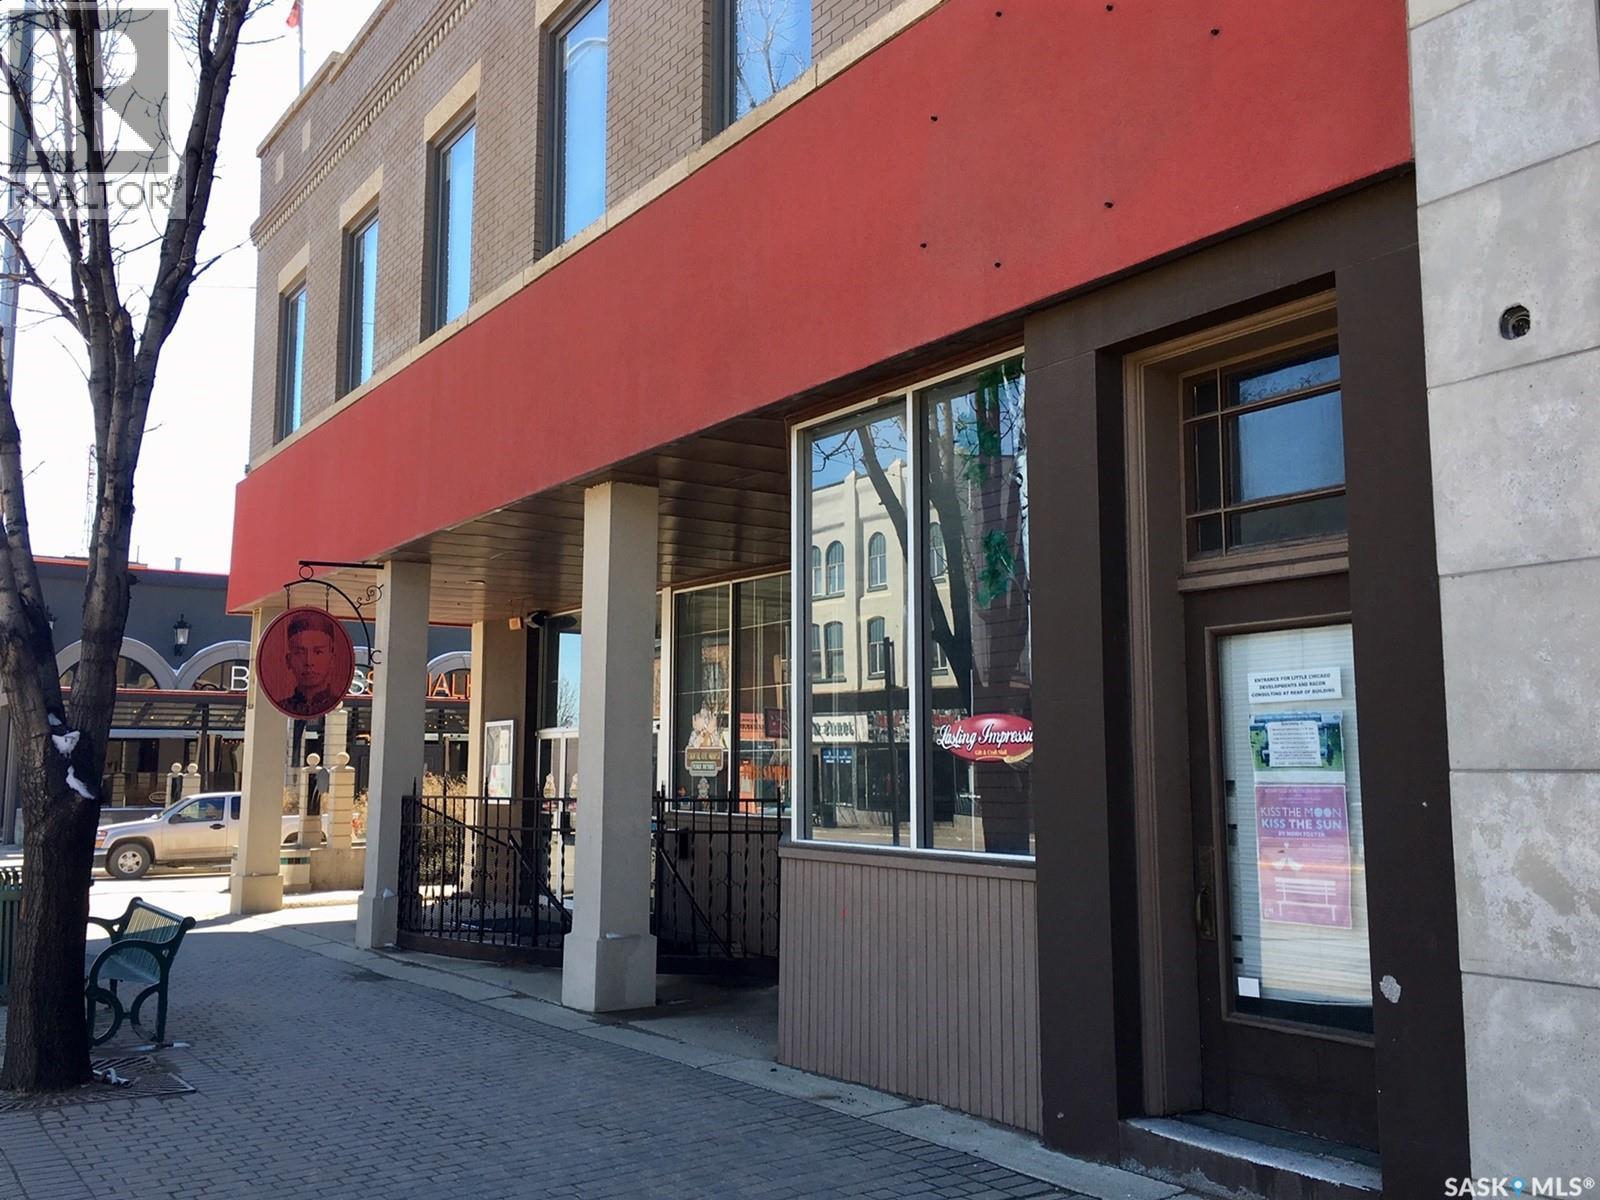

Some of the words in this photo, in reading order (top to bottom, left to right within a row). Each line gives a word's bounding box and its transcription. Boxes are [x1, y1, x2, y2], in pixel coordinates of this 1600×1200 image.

[1308, 672, 1331, 680] CHICAGO
[936, 724, 977, 751] Lasting
[978, 721, 1033, 748] Impressi
[1260, 806, 1281, 817] KISS
[1282, 807, 1301, 817] THE
[1304, 807, 1342, 818] MOON
[1262, 818, 1286, 829] KISS
[1288, 819, 1313, 830] THE
[1315, 819, 1343, 831] SUN
